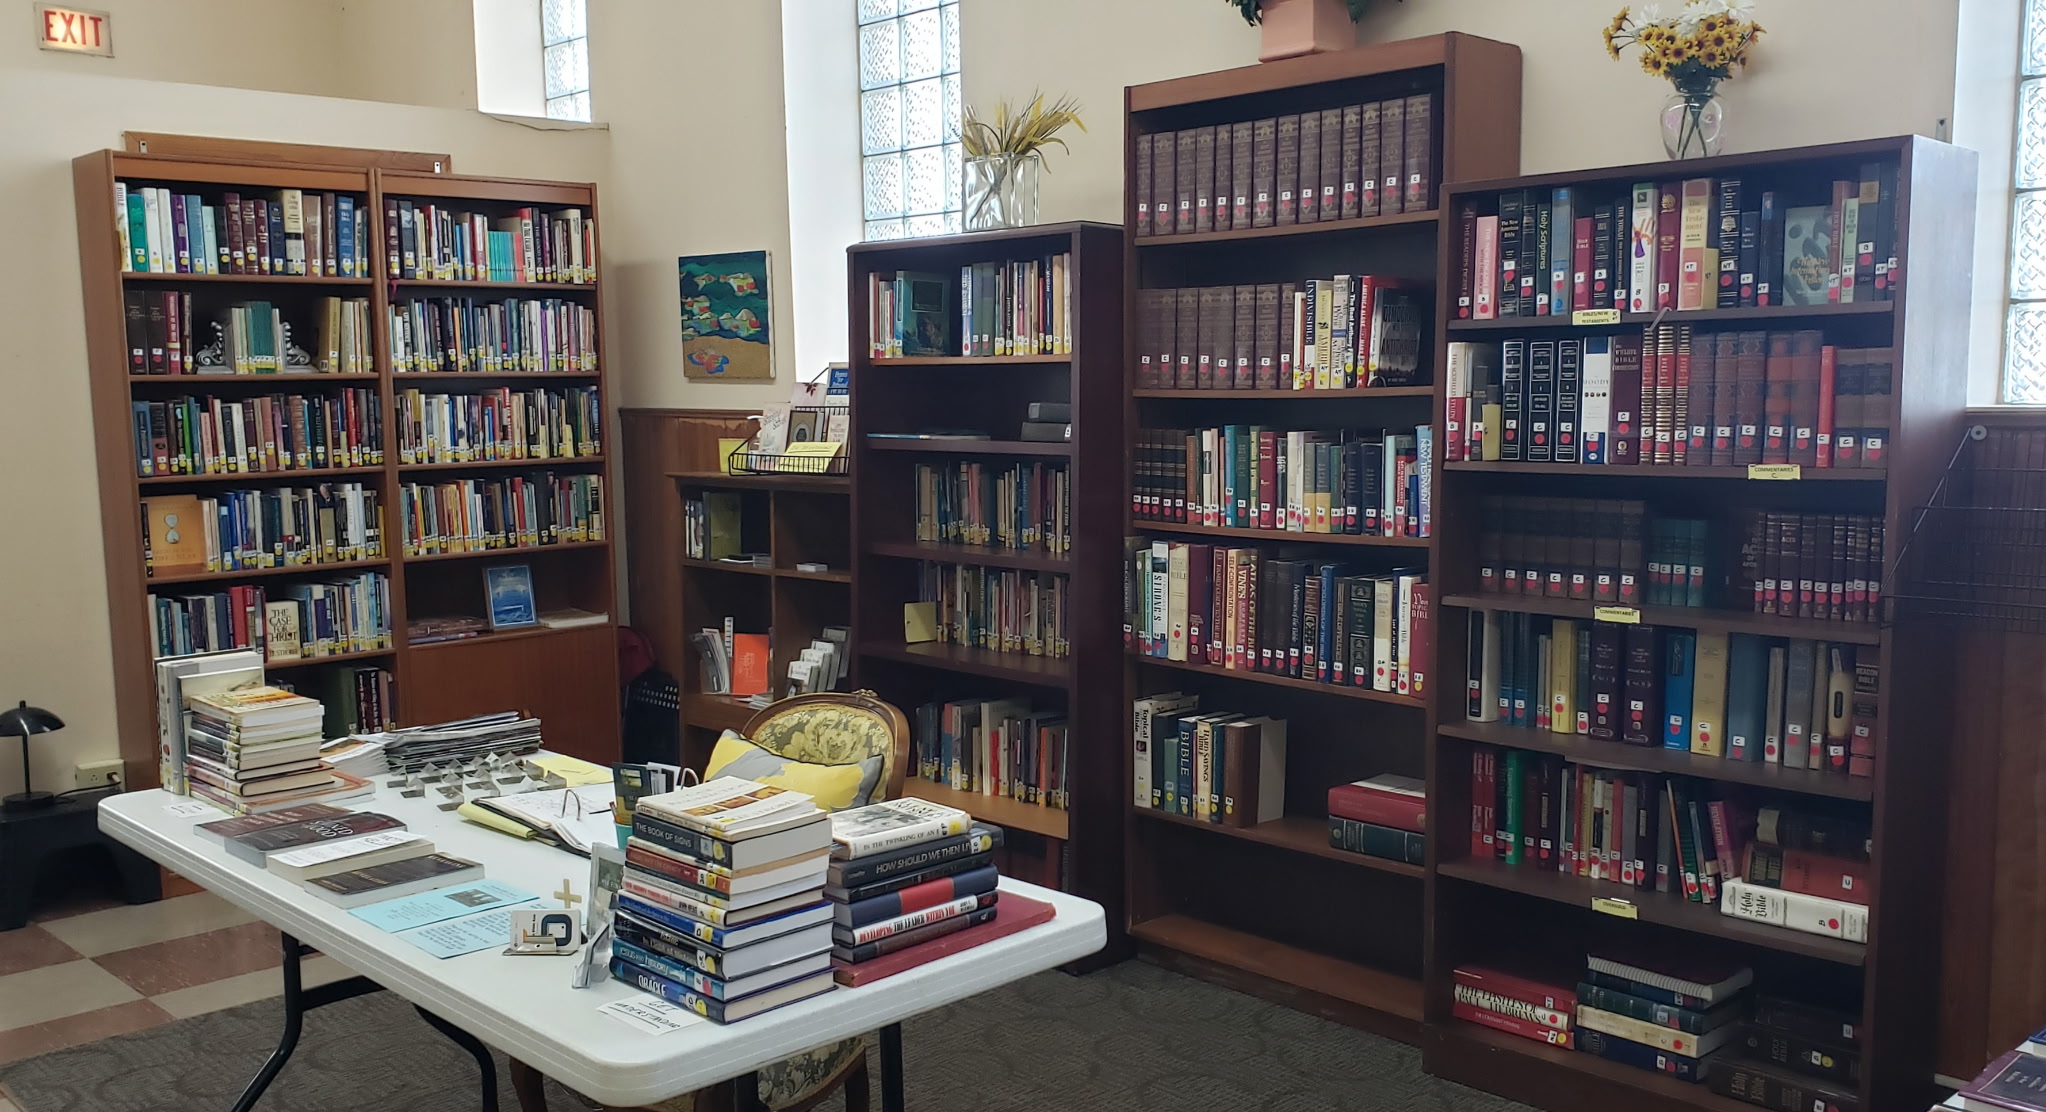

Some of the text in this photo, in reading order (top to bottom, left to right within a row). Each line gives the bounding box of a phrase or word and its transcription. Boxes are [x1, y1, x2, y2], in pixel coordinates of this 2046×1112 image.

[44, 10, 102, 47] EXIT
[1538, 210, 1548, 270] Holy Scriptures
[1306, 283, 1315, 344] INDIVISIBLE
[1419, 439, 1428, 504] NEW TESTAMENT
[1227, 555, 1235, 619] SELF-CONFRONTATION
[1237, 569, 1246, 599] VINE'S
[1249, 562, 1257, 598] ATLAS
[1153, 575, 1162, 622] STRONG'S
[1292, 583, 1300, 612] Mysteries
[1599, 608, 1635, 616] COMMENTARIES
[269, 616, 292, 626] CASE
[271, 608, 289, 618] THE
[268, 632, 297, 642] CHRIST
[1181, 730, 1190, 776] BIBLE
[635, 822, 692, 848] THE BOOK OF SIGNS
[872, 841, 883, 849] THE
[885, 834, 916, 846] TWINKLING
[926, 829, 935, 837] AN
[1711, 806, 1724, 846] REVELATION
[876, 845, 961, 874] HOW SHOULD WE THEN
[1740, 889, 1753, 915] Holy
[1755, 894, 1767, 918] Bible
[859, 905, 955, 943] DEVELOPING THE LEADER WITHIN YOU
[638, 974, 667, 997] ORACLE
